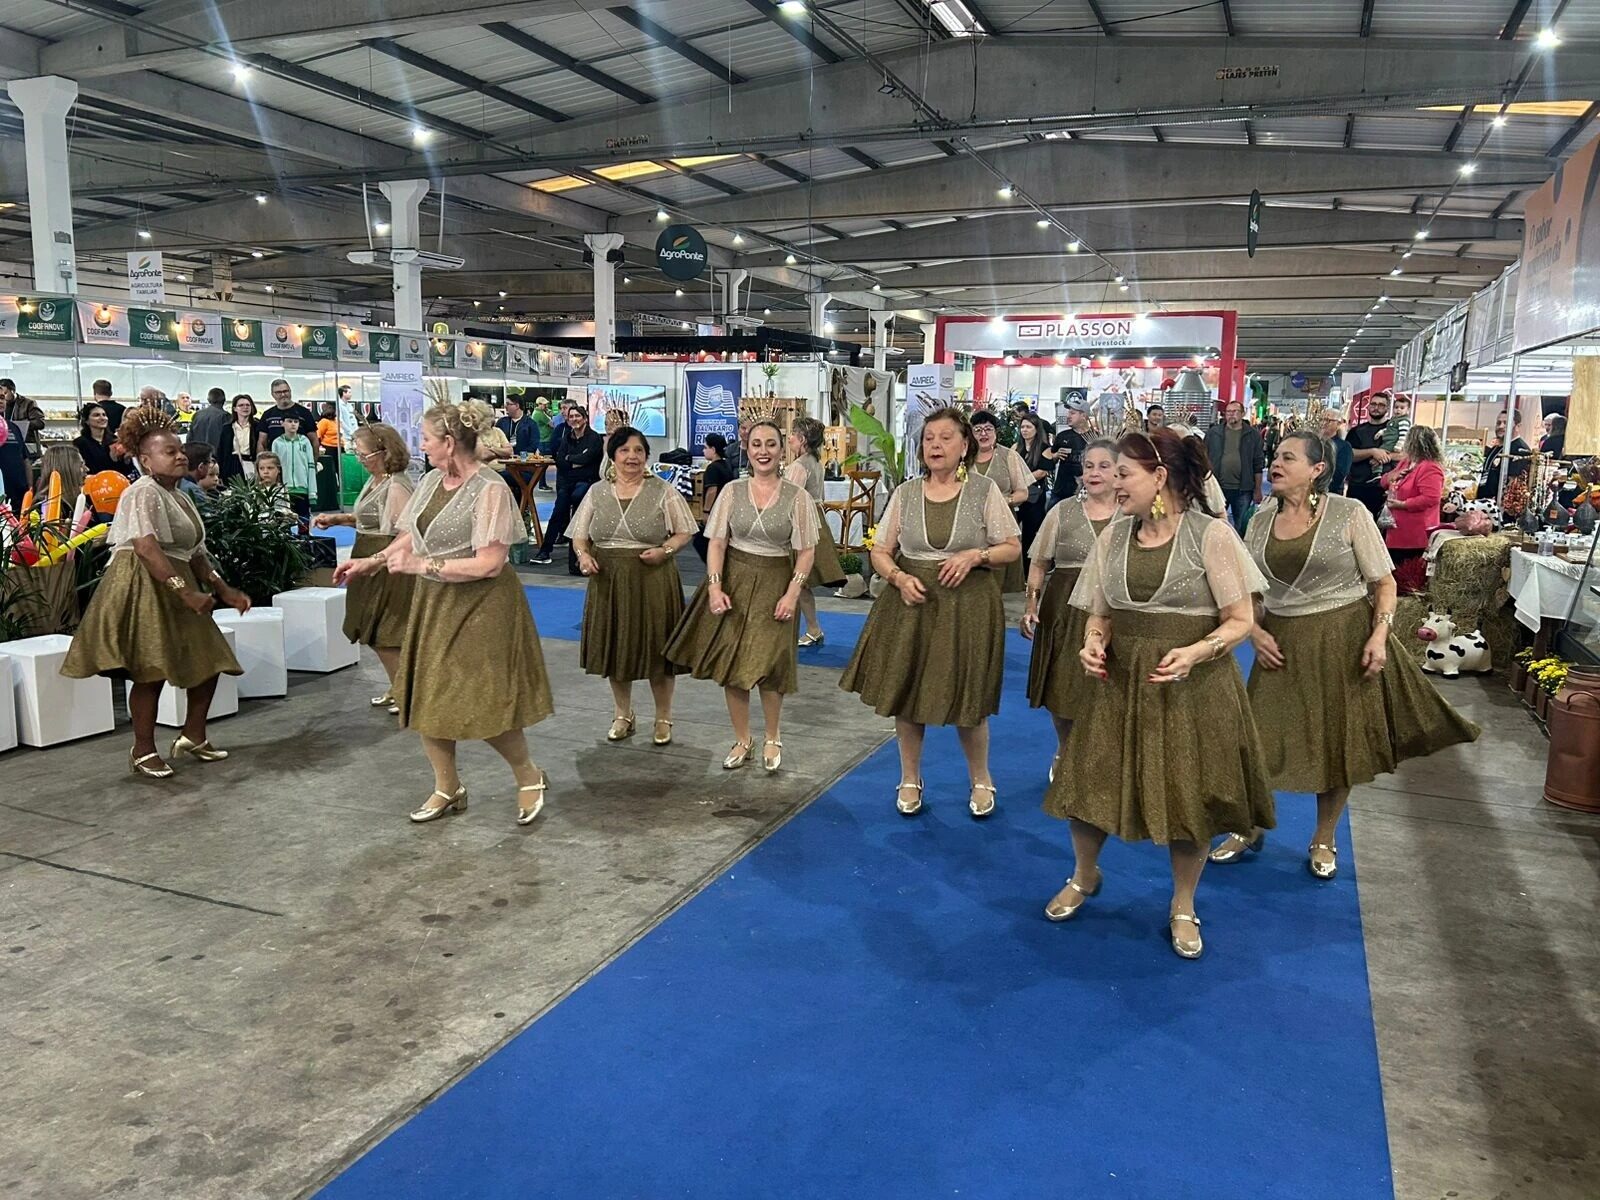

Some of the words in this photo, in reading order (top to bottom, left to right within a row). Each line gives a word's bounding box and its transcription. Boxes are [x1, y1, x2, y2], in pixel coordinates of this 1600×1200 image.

[660, 247, 704, 261] AgroPonte
[130, 269, 162, 280] AgroPonte
[1046, 321, 1131, 337] PLASSON
[1091, 339, 1127, 347] Livestock
[385, 372, 415, 380] AMREC
[911, 375, 935, 385] AMREC
